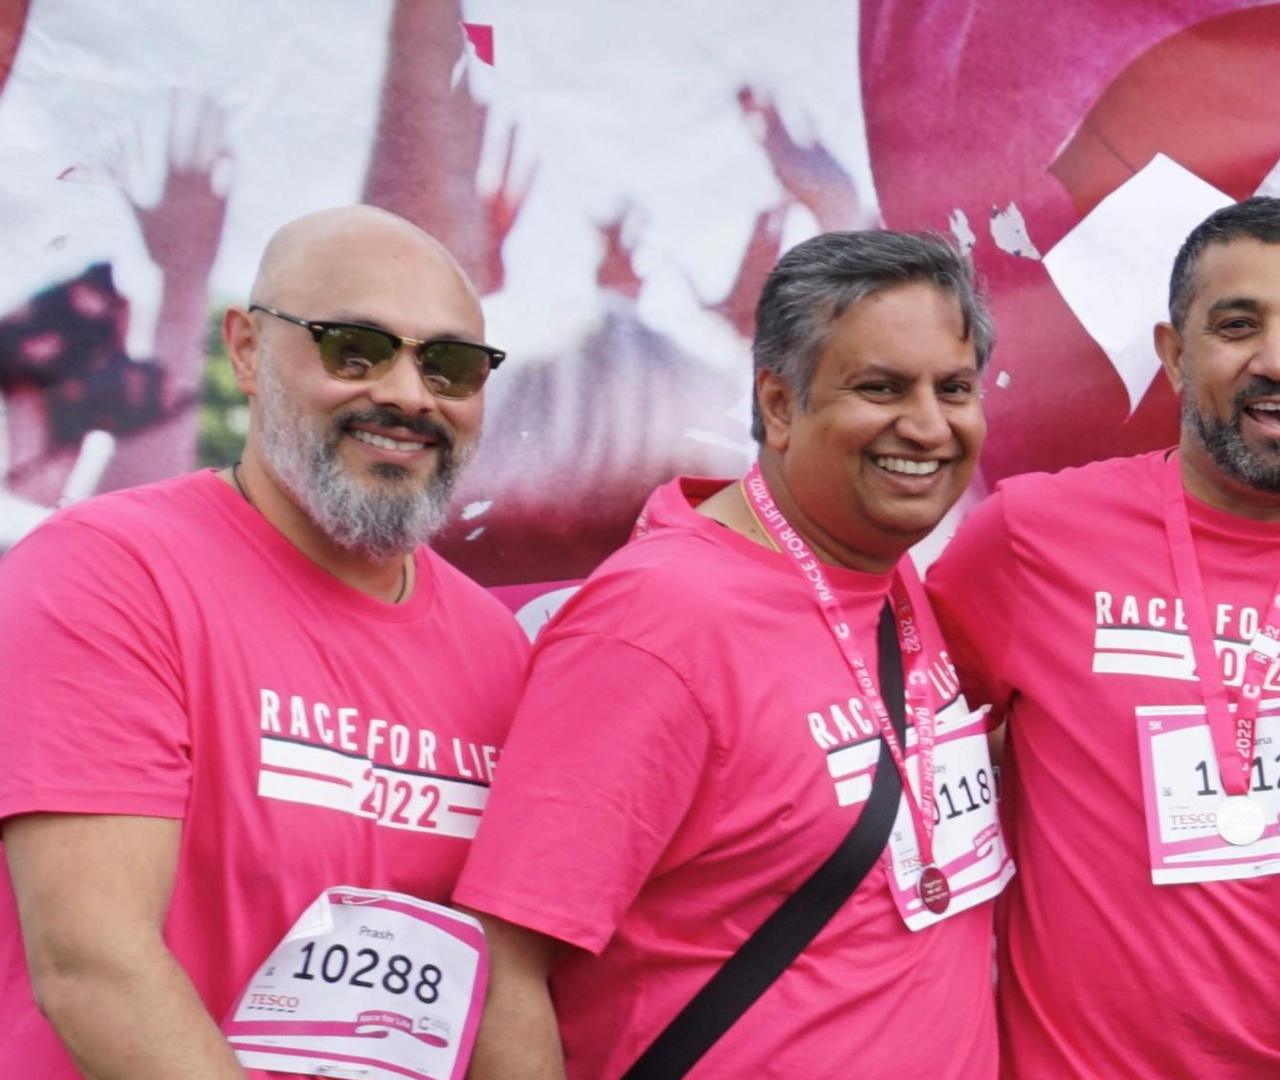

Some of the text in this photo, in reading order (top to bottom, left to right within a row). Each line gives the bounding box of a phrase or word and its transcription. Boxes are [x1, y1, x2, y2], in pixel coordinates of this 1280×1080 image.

[760, 499, 788, 529] LIFE
[780, 526, 809, 559] FOR
[901, 618, 921, 653] 2022
[1216, 602, 1259, 640] FO
[852, 658, 877, 697] 2022
[260, 688, 501, 782] RACE FOR LIF
[807, 695, 875, 751] RAC
[1170, 811, 1218, 826] TESCO
[358, 925, 395, 941] Prash
[292, 940, 442, 1005] 10288
[250, 993, 300, 1008] TESCO
